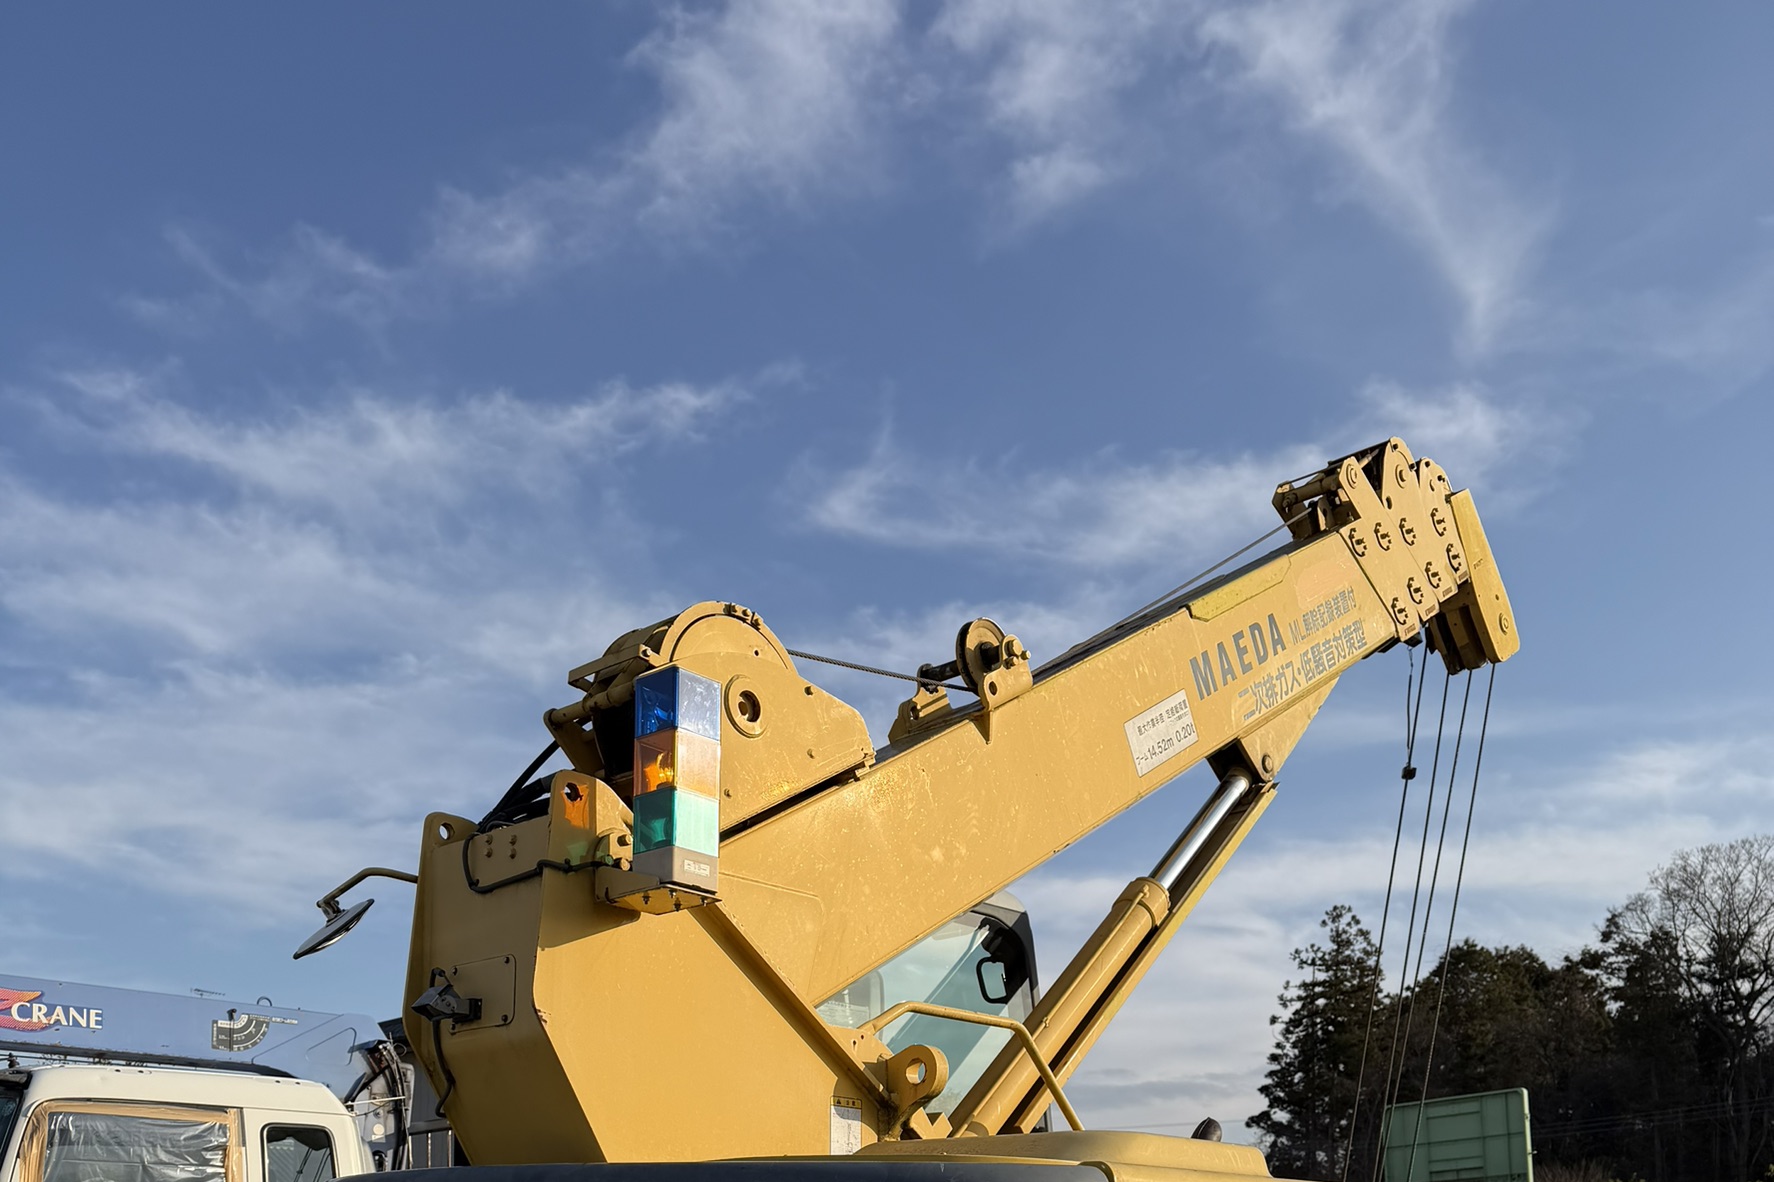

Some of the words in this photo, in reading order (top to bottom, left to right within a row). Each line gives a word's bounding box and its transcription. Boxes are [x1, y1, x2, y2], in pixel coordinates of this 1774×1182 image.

[1189, 613, 1287, 701] MAEDA
[1237, 617, 1368, 721] 二次排ガス・低騒音対策型
[1175, 722, 1196, 743] 0.20t
[11, 1001, 103, 1030] CRANE
